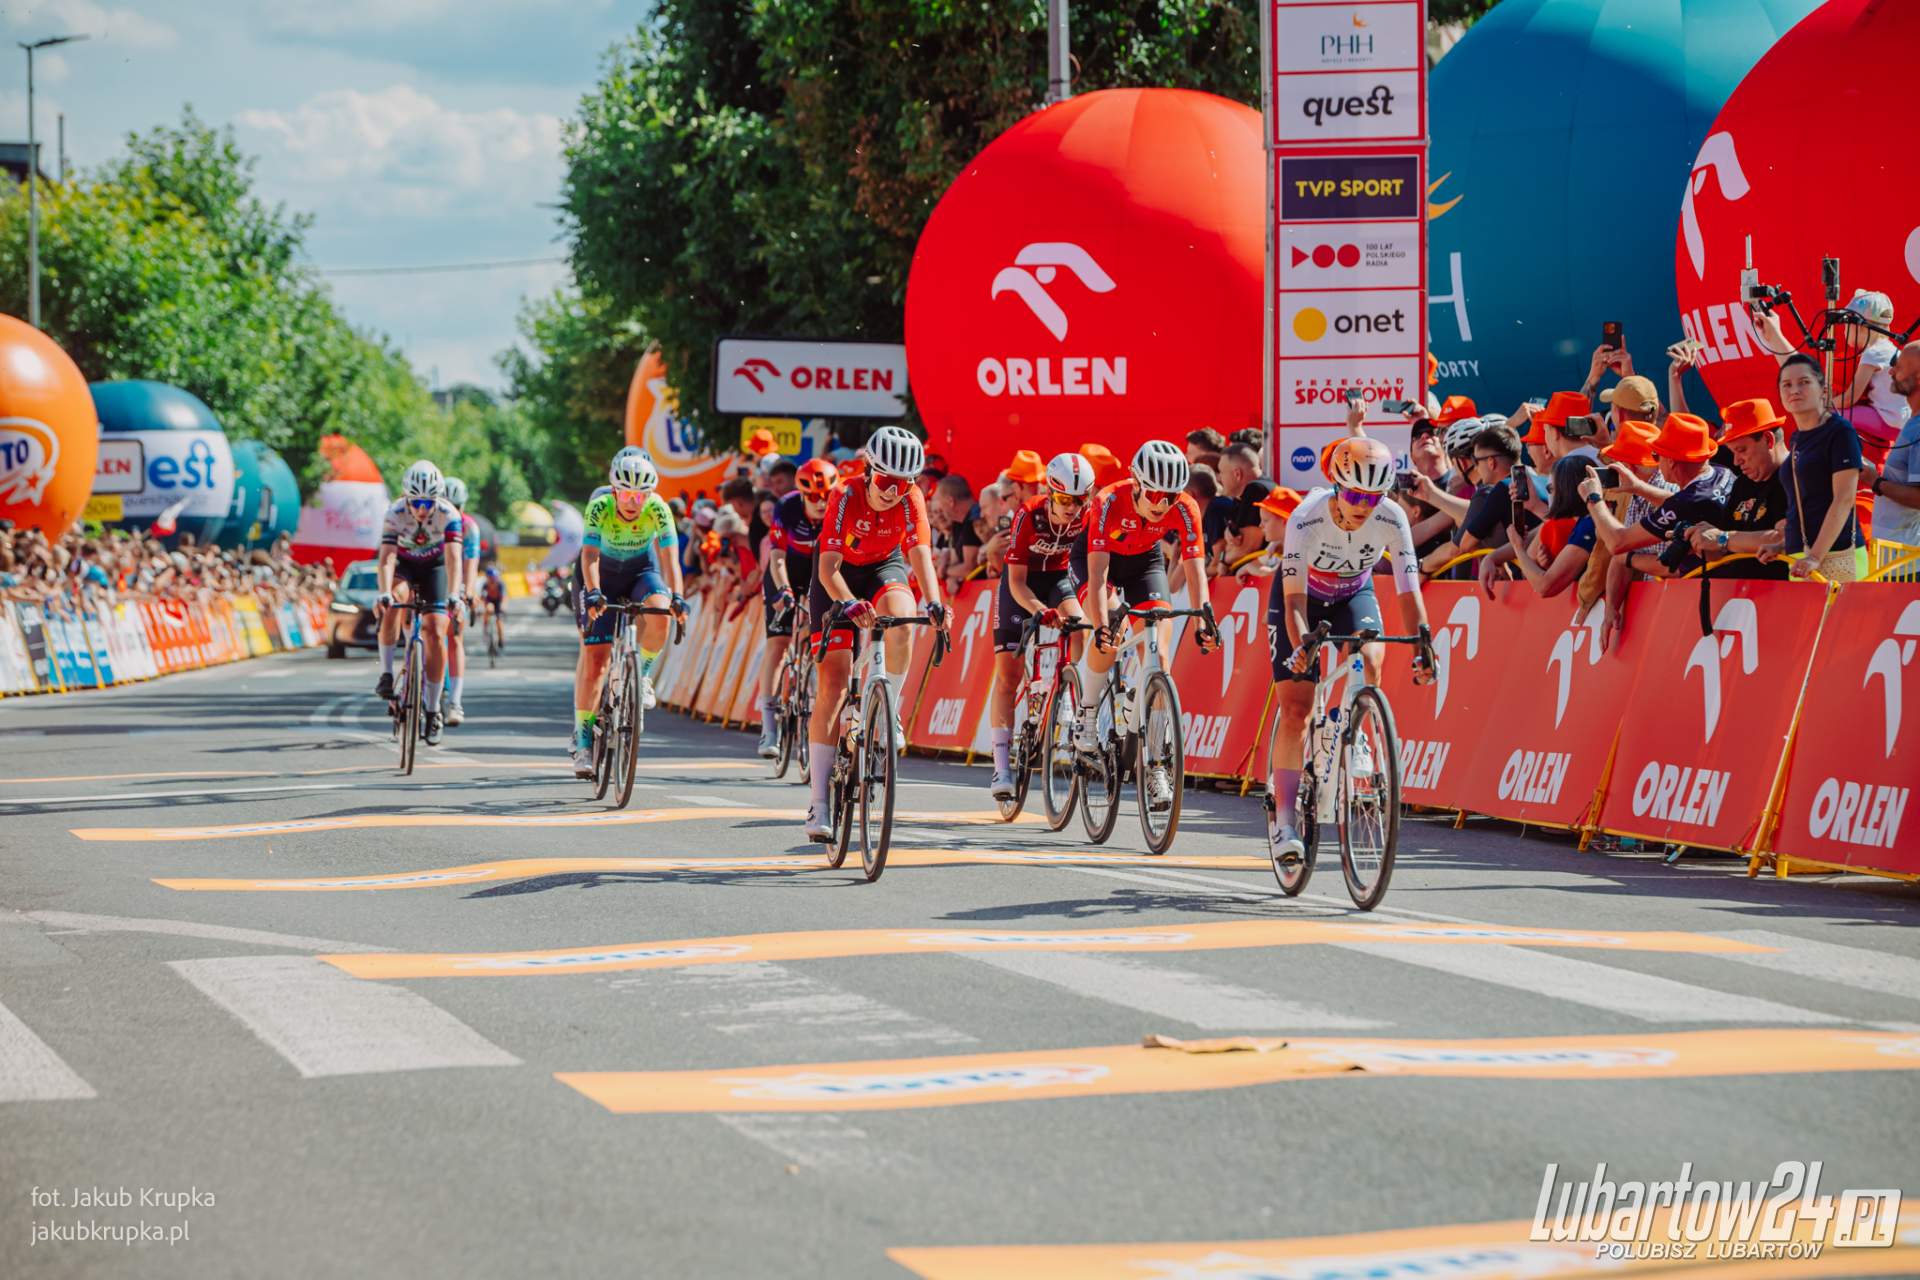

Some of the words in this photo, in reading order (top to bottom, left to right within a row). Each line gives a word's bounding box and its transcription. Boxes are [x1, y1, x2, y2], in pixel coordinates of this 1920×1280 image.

[1321, 34, 1373, 56] PHH
[1303, 85, 1394, 126] quest
[1296, 180, 1336, 197] TVP
[1341, 178, 1404, 197] SPORT
[1334, 309, 1405, 333] onet
[791, 367, 893, 391] ORLEN
[976, 356, 1128, 397] ORLEN
[1295, 387, 1404, 404] SPOROWY
[1394, 738, 1451, 790] RLEN
[1498, 749, 1572, 804] ORLEN
[1632, 760, 1731, 827] ORLEN
[1809, 777, 1910, 848] ORLEN
